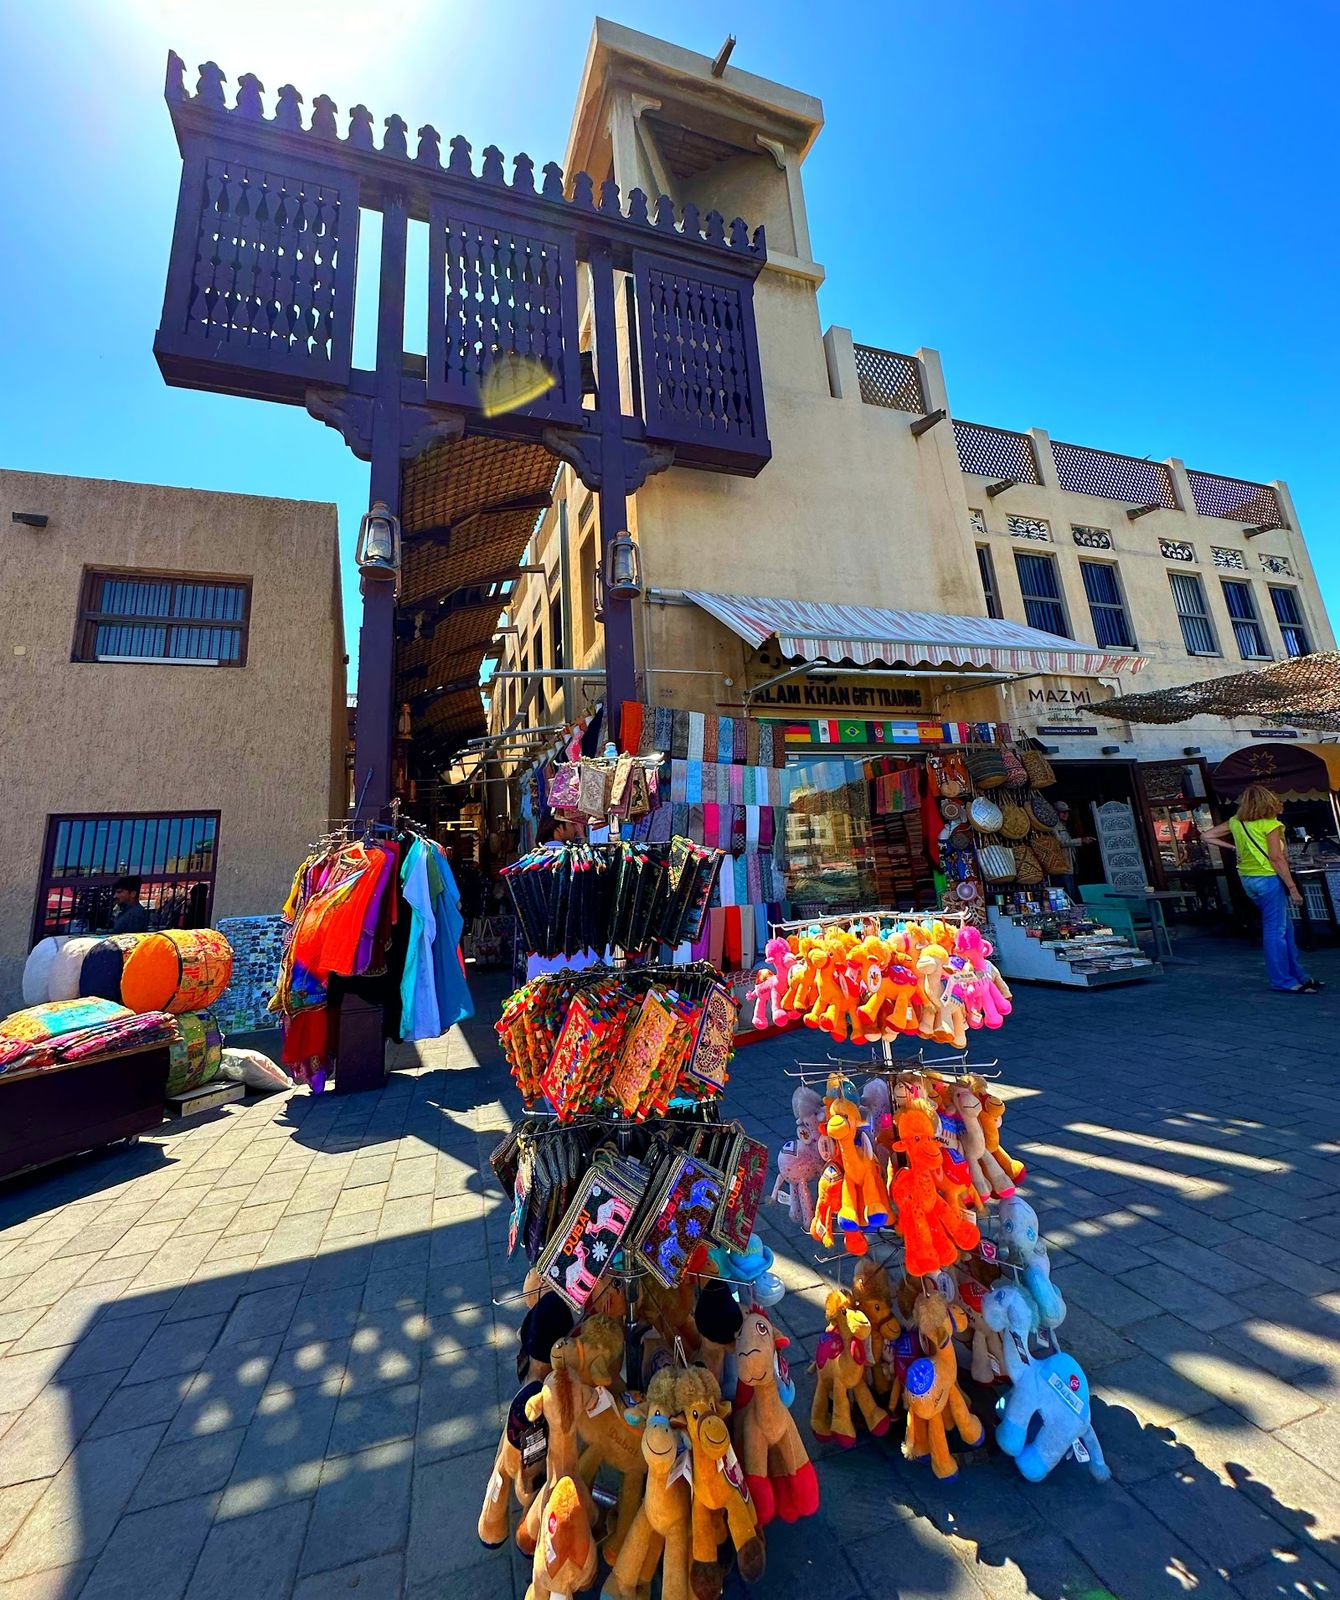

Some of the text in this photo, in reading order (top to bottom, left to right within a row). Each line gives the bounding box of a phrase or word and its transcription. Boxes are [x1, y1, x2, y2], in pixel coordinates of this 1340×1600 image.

[804, 685, 850, 706] KHAN
[852, 687, 876, 706] GIFT
[876, 688, 922, 707] TRADING
[657, 1185, 684, 1231] DUBAI
[728, 1165, 745, 1208] DUBAI
[563, 1208, 590, 1256] DUBAI
